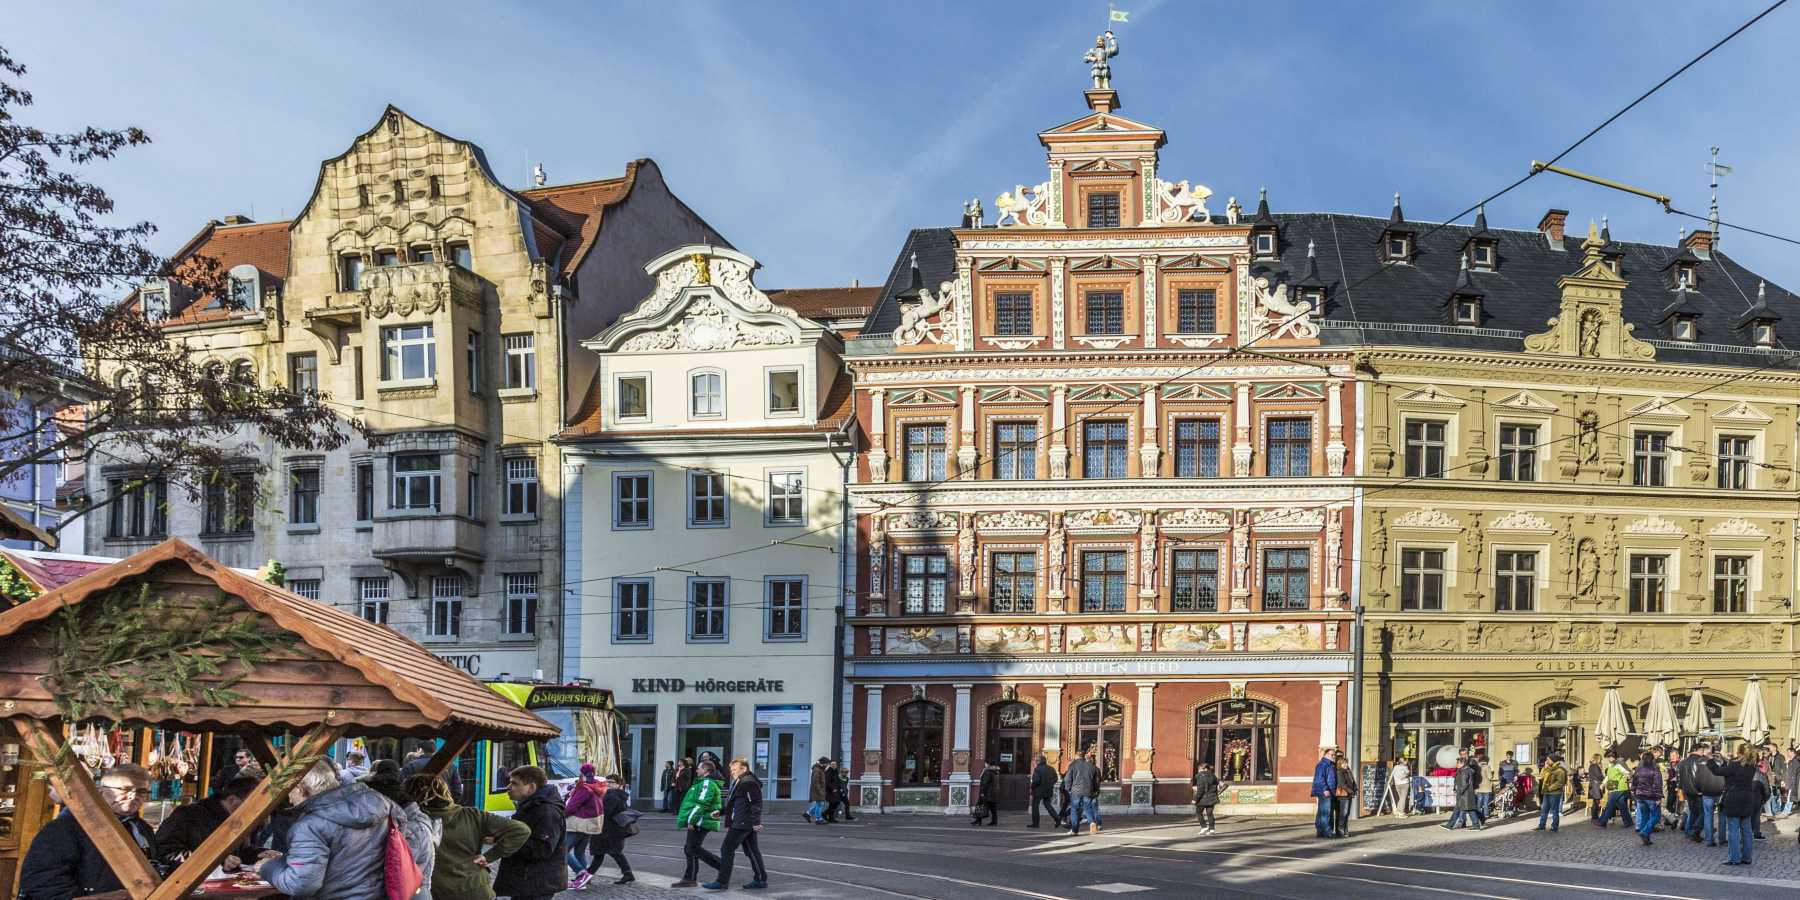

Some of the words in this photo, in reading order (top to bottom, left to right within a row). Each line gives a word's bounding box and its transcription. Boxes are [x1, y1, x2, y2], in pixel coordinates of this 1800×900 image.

[1065, 662, 1128, 673] BREITEN
[1137, 661, 1180, 673] HERD
[1535, 661, 1635, 671] GILDEHAUS
[632, 678, 686, 693] KIND
[695, 677, 785, 693] HÖRGERÄTE
